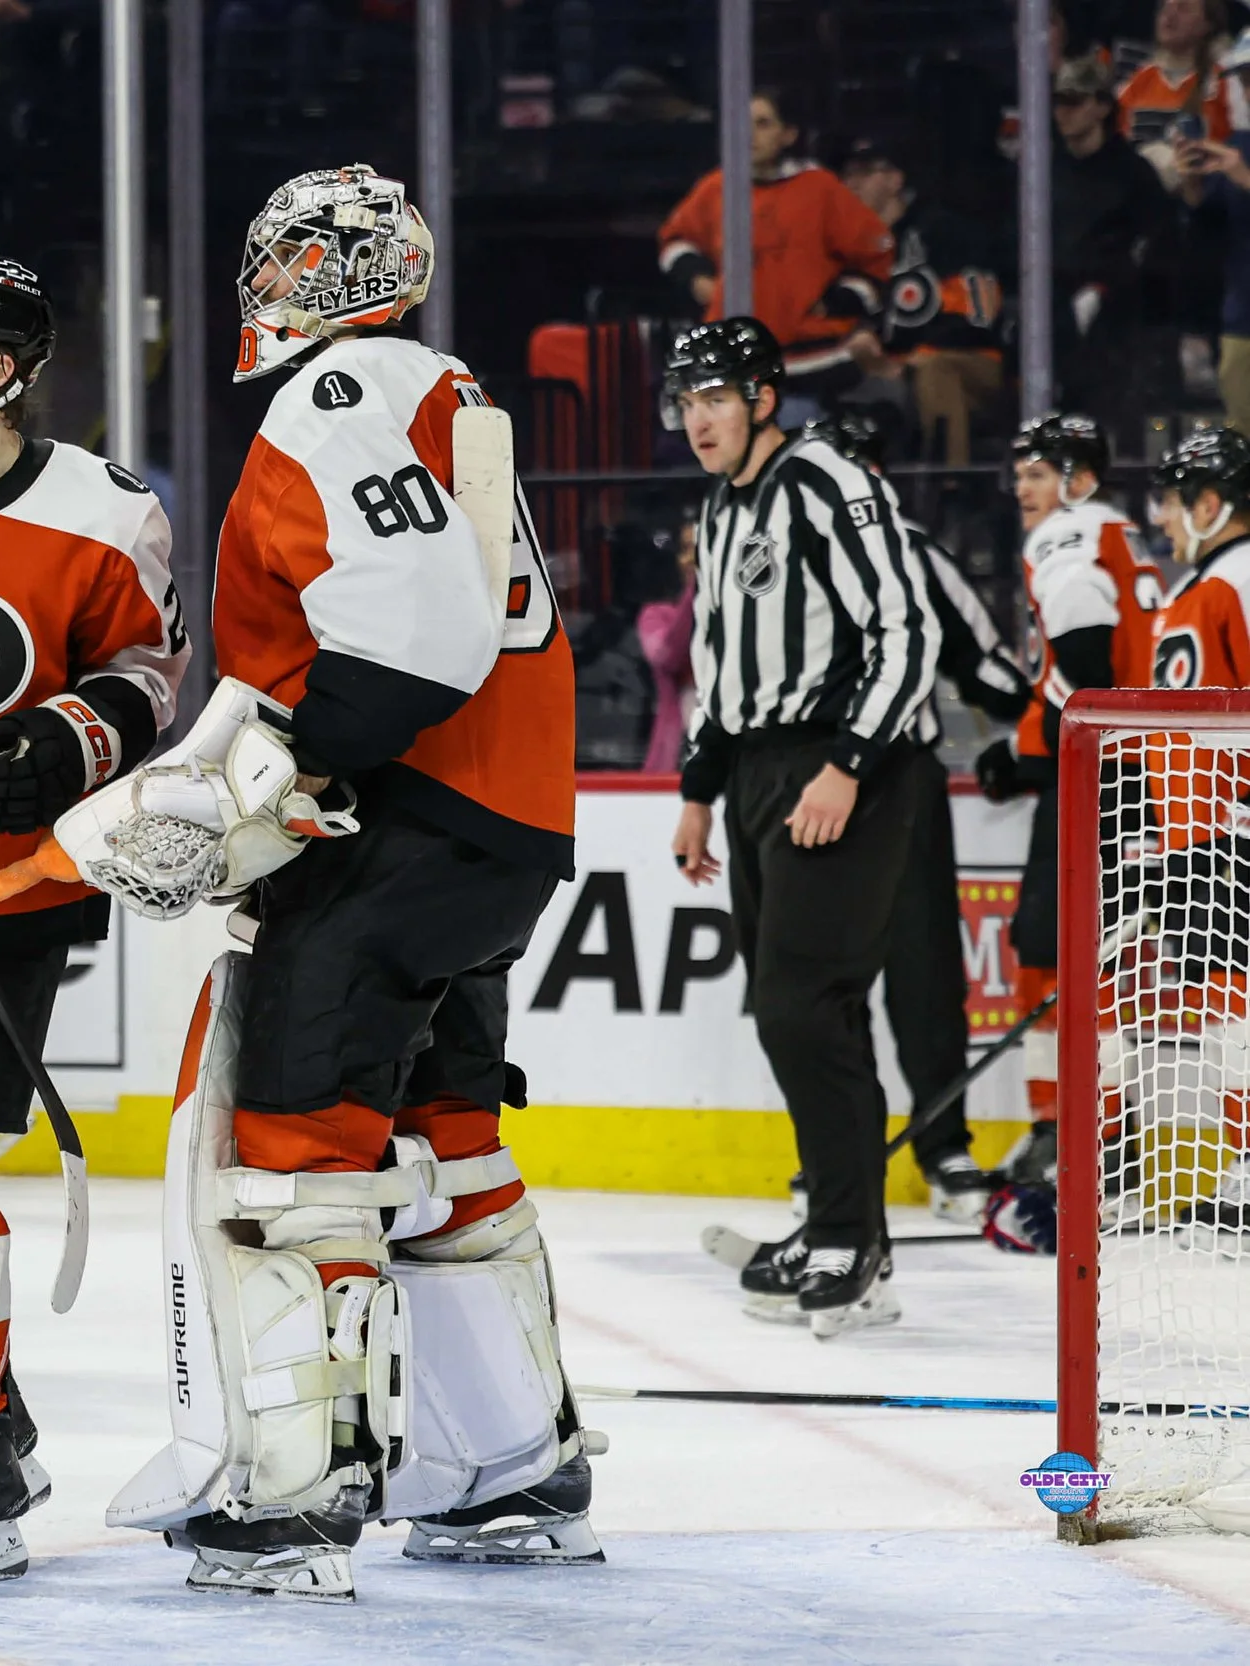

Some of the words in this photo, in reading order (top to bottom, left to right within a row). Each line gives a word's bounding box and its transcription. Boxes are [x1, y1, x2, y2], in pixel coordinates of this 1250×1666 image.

[302, 270, 399, 313] FLYERS
[324, 373, 349, 406] 1
[351, 463, 449, 539] 80
[847, 499, 878, 528] 97
[528, 871, 752, 1015] AP
[170, 1262, 191, 1410] SUPREME
